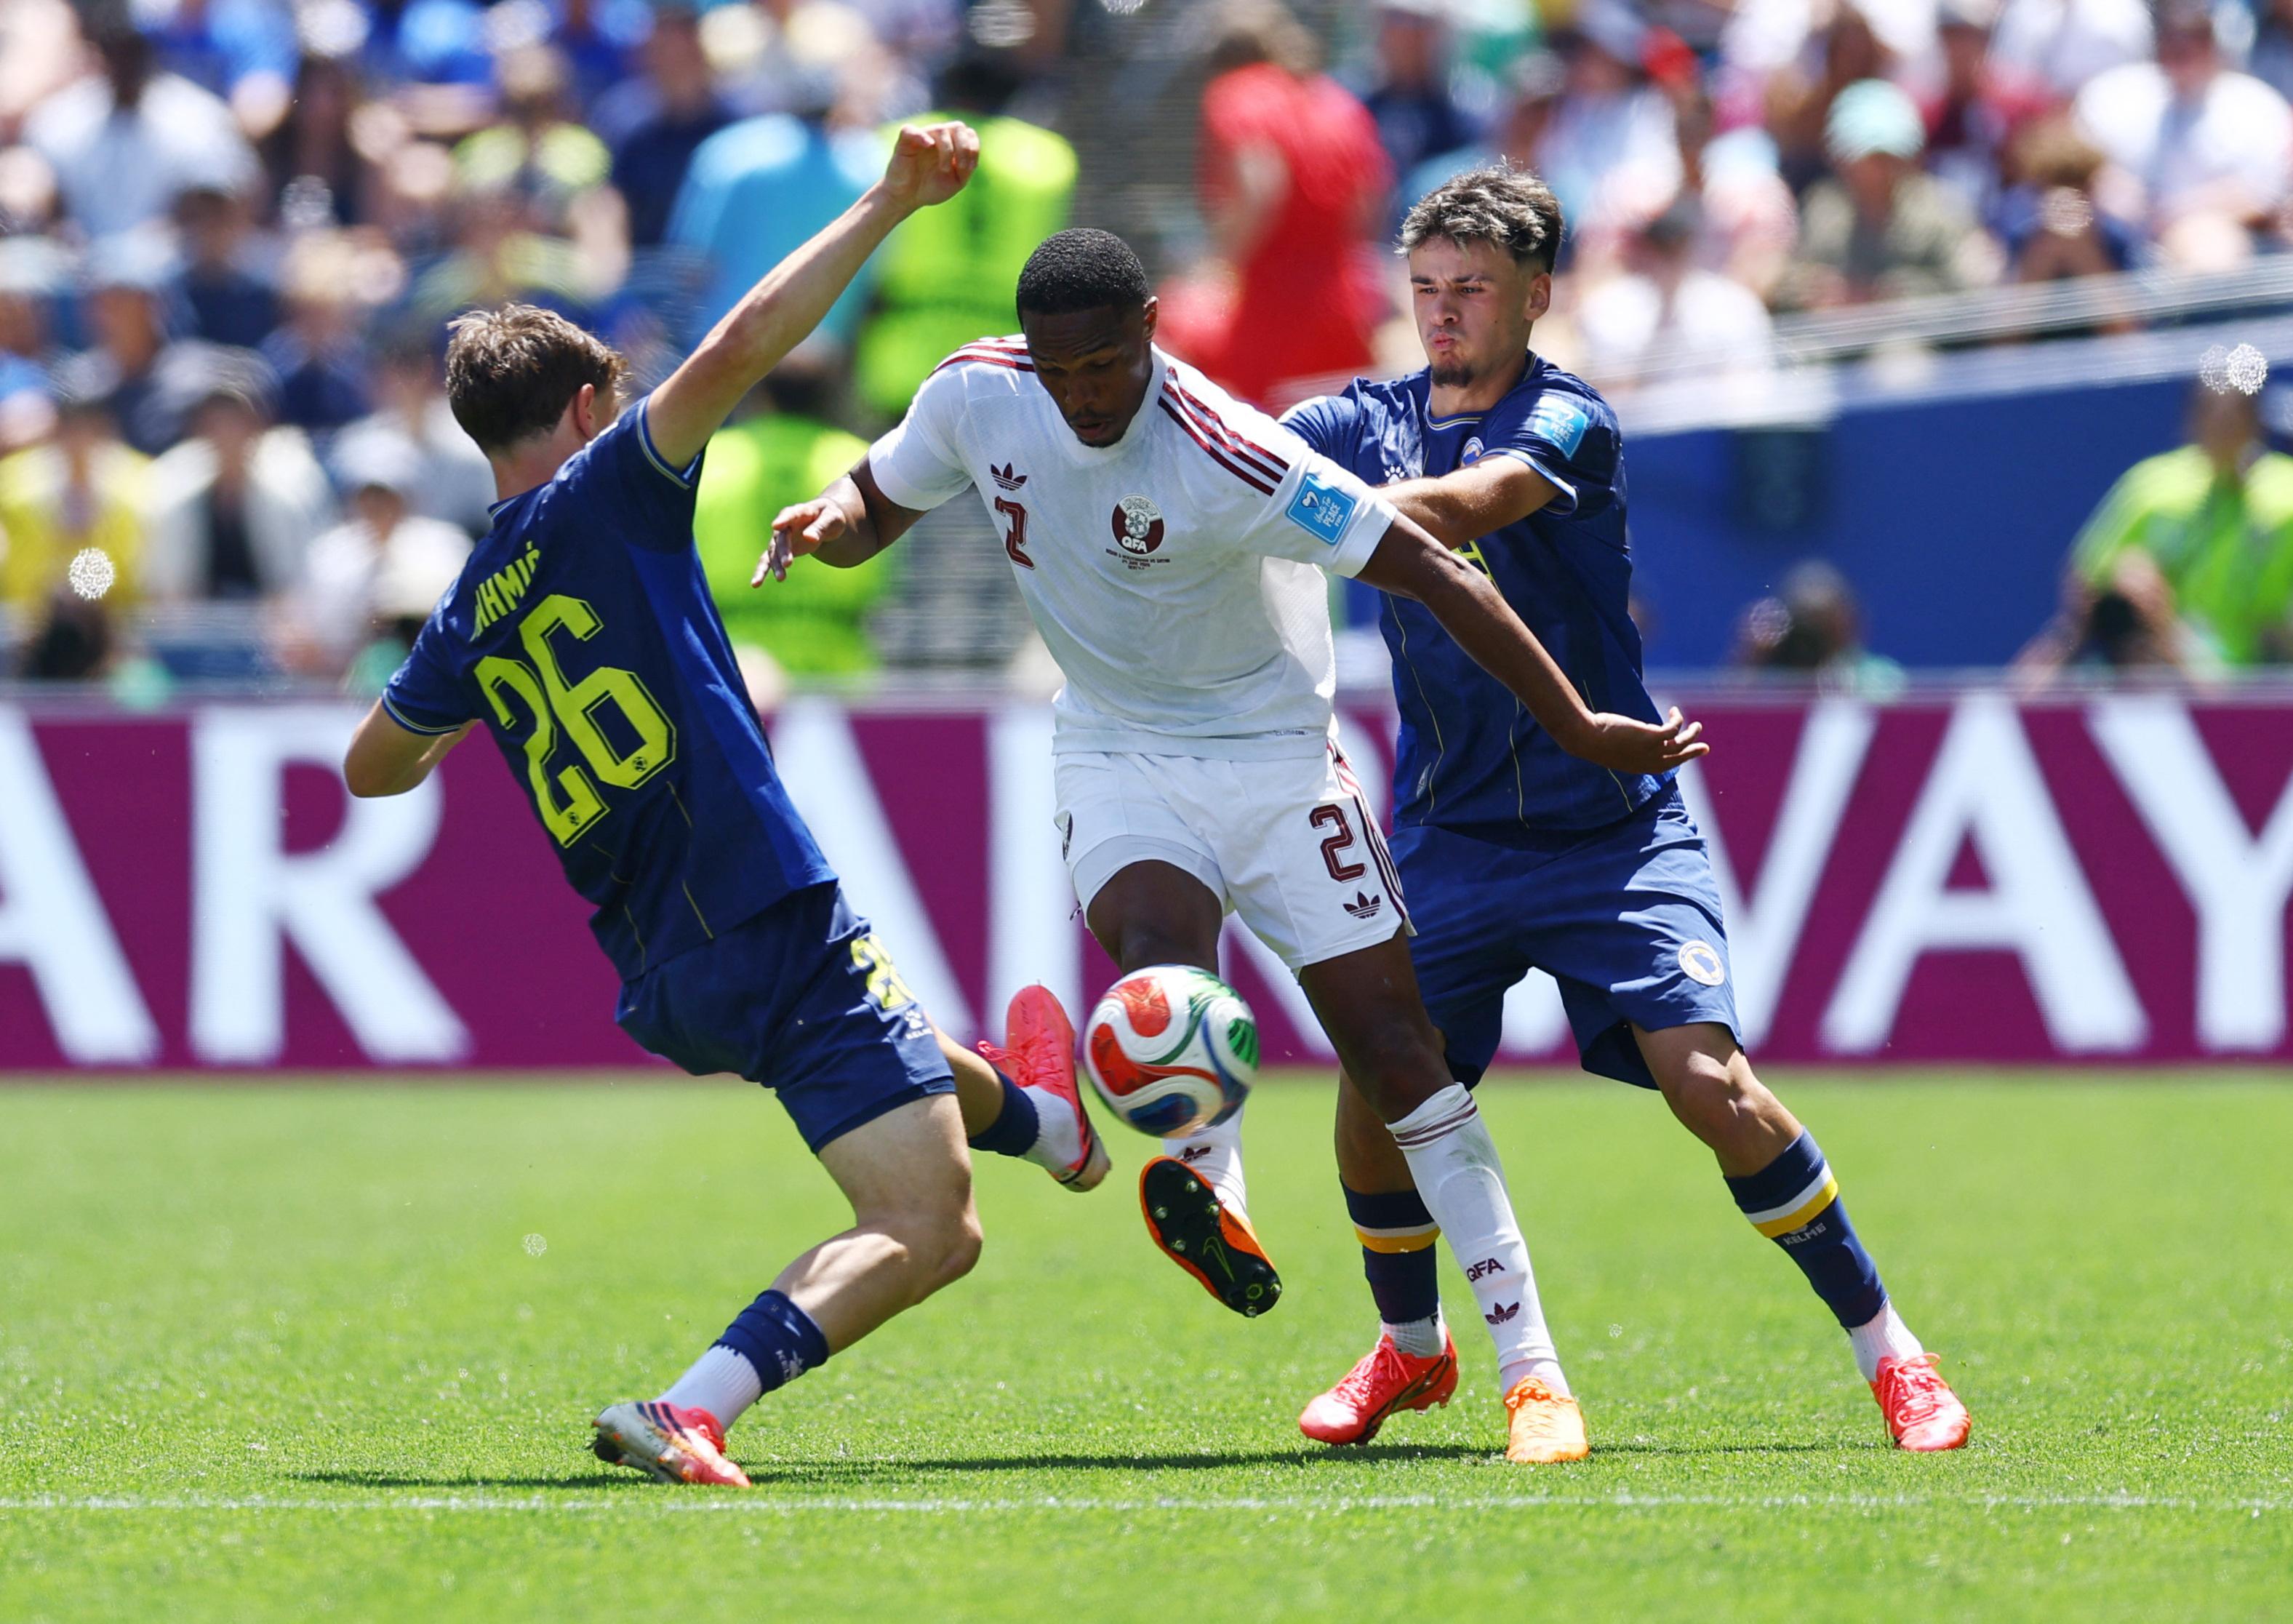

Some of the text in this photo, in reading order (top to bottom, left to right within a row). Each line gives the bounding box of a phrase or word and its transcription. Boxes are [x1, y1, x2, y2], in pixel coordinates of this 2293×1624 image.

[995, 495, 1036, 571] 2
[1323, 502, 1341, 528] PEACE
[1334, 514, 1344, 527] FIFA
[1121, 536, 1148, 553] QFA
[470, 540, 540, 641] AHMIĆ
[474, 594, 676, 849] 26
[1309, 804, 1368, 884] 2
[1467, 1257, 1505, 1282] QFA
